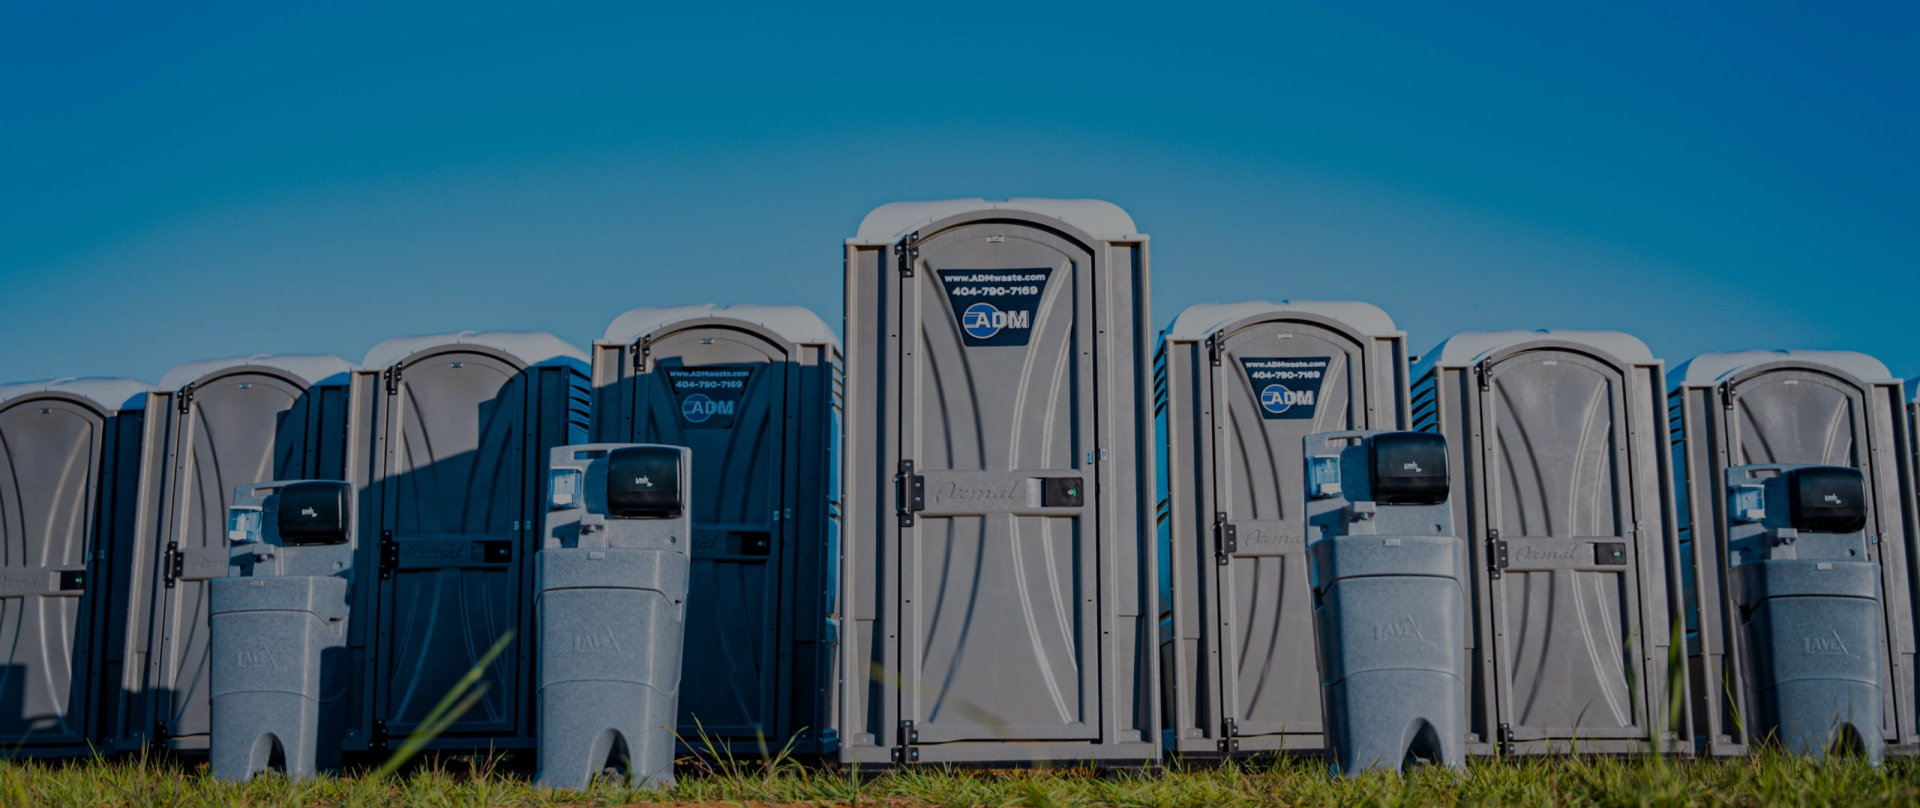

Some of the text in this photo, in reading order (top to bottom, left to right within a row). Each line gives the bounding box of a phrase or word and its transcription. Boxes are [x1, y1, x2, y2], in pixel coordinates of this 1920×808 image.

[944, 274, 1046, 283] www.ADMwaste.com
[952, 286, 1038, 296] 404-790-7169
[974, 310, 1030, 329] ADM
[1252, 371, 1321, 379] 404-790-7169
[675, 380, 743, 389] 404-790-7169
[1271, 390, 1315, 406] ADM
[691, 400, 735, 415] ADM
[933, 480, 1019, 503] Armal
[1243, 529, 1304, 547] Arma
[1514, 544, 1579, 562] Armal
